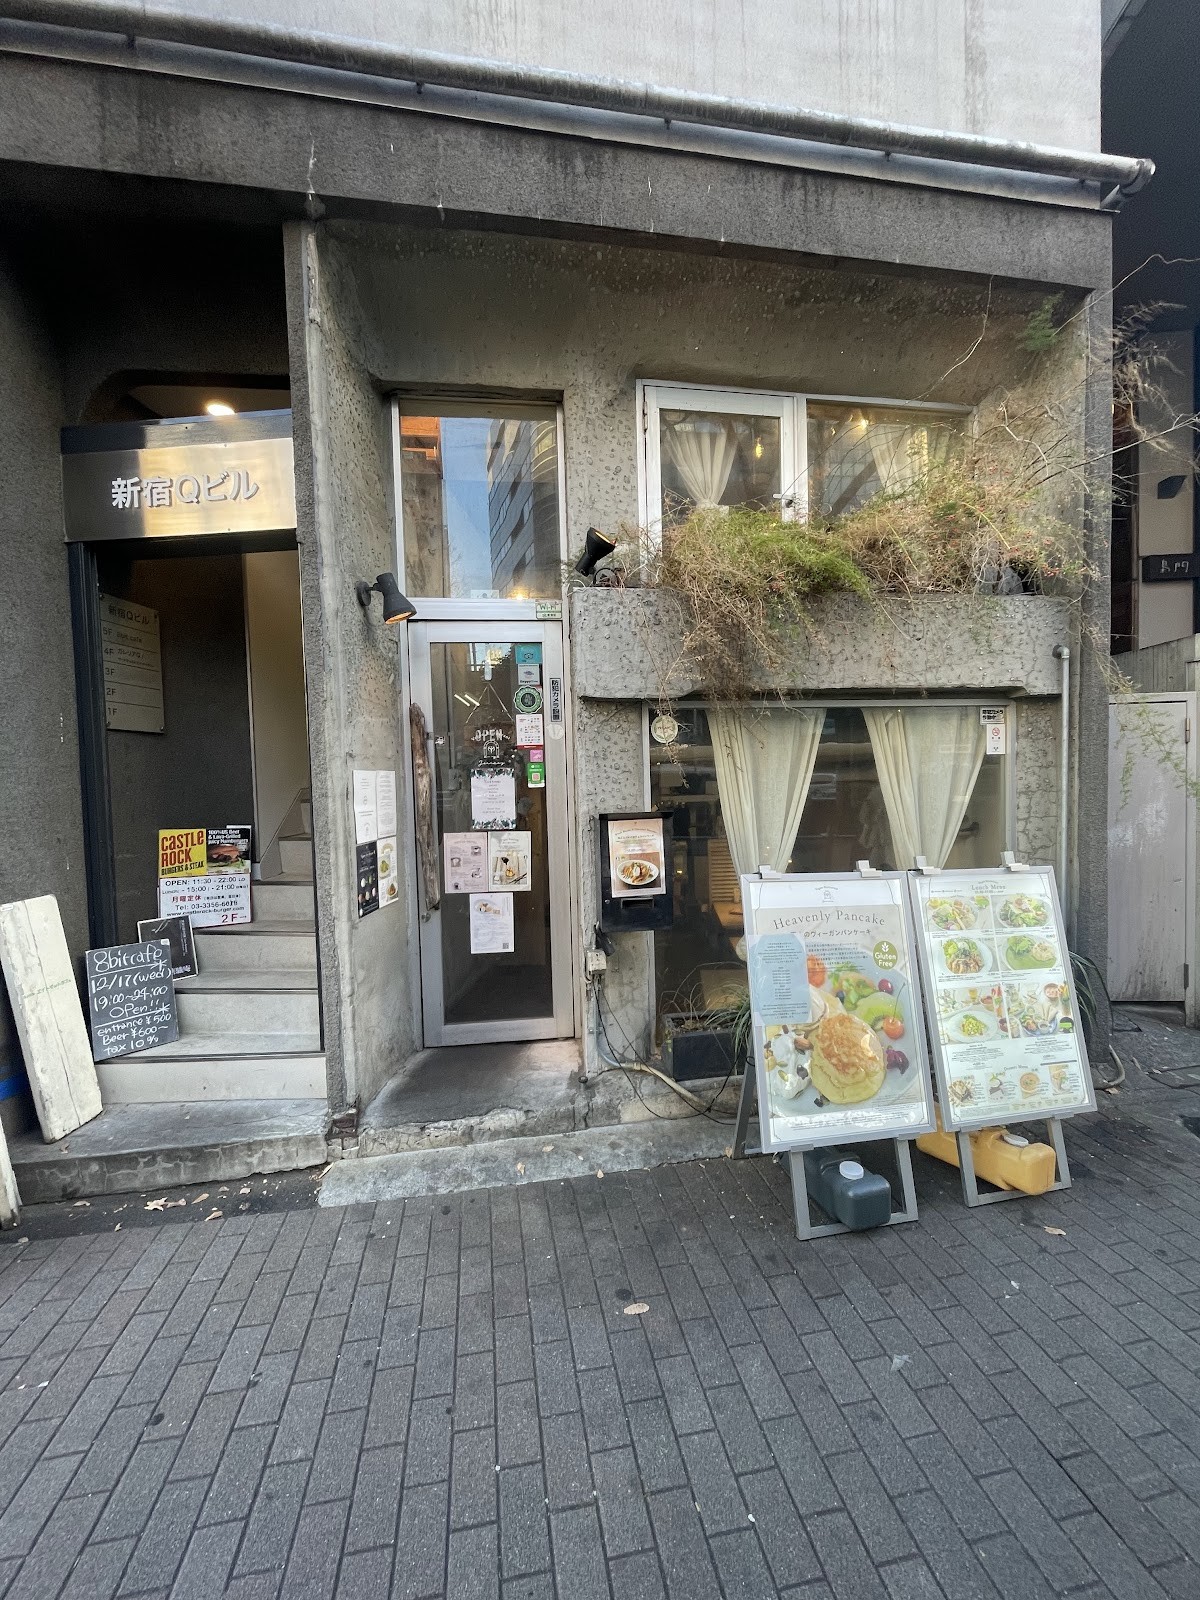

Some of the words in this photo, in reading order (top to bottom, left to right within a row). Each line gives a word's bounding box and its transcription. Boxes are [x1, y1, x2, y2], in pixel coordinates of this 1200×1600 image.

[111, 470, 260, 509] 新宿Qビル
[108, 604, 150, 625] 新宿Qビル
[103, 648, 114, 656] 4F
[105, 667, 115, 676] 3F
[106, 687, 117, 696] 2F
[107, 707, 118, 716] 1F
[475, 729, 503, 741] OPEN
[161, 848, 192, 867] ROCK
[161, 864, 184, 875] BURGERS
[189, 861, 205, 870] STEAK
[172, 895, 202, 903] 月曜定休
[773, 910, 831, 930] Heavenly
[836, 909, 885, 926] Pancake
[875, 952, 896, 961] Gluten
[878, 959, 893, 968] Free
[97, 1018, 143, 1037] entrance
[102, 1032, 130, 1046] Beer
[103, 1043, 127, 1056] tax
